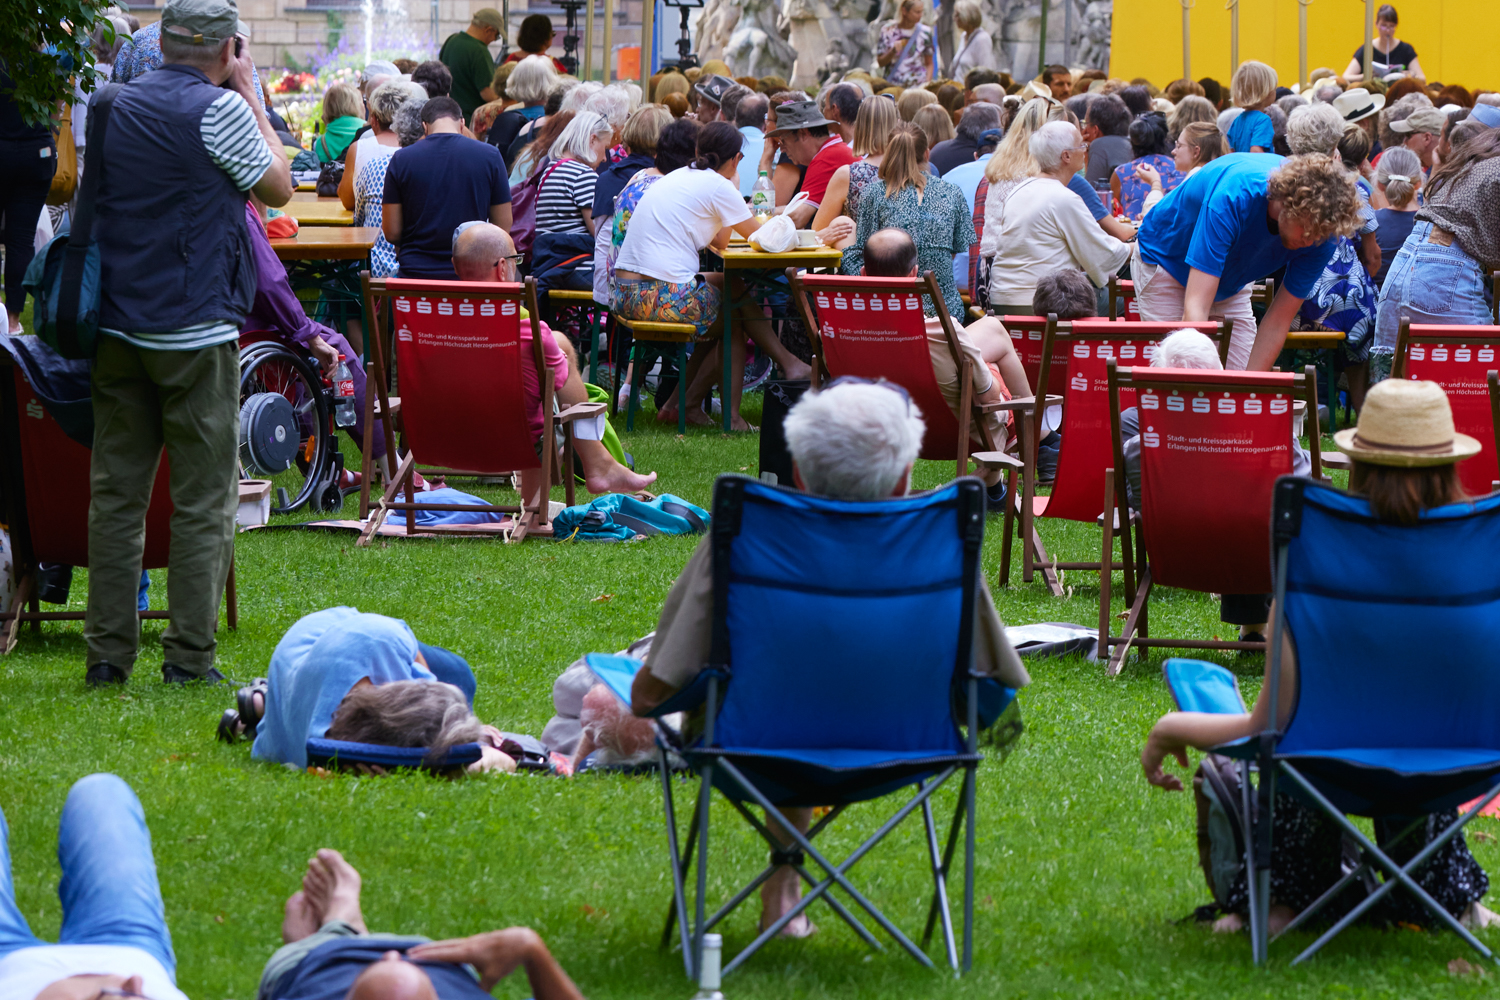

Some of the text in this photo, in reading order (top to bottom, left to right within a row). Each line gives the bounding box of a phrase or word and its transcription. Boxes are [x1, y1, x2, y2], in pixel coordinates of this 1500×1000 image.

[436, 333, 447, 341] und
[447, 334, 489, 342] Kreissparkasse
[418, 339, 443, 347] Erlangen
[472, 340, 517, 349] Herzogenaurach
[1166, 434, 1187, 442] Stadt-
[1203, 437, 1253, 445] Kreissparkasse
[1167, 442, 1287, 455] Erlangen Höchstadt Herzogenaurach
